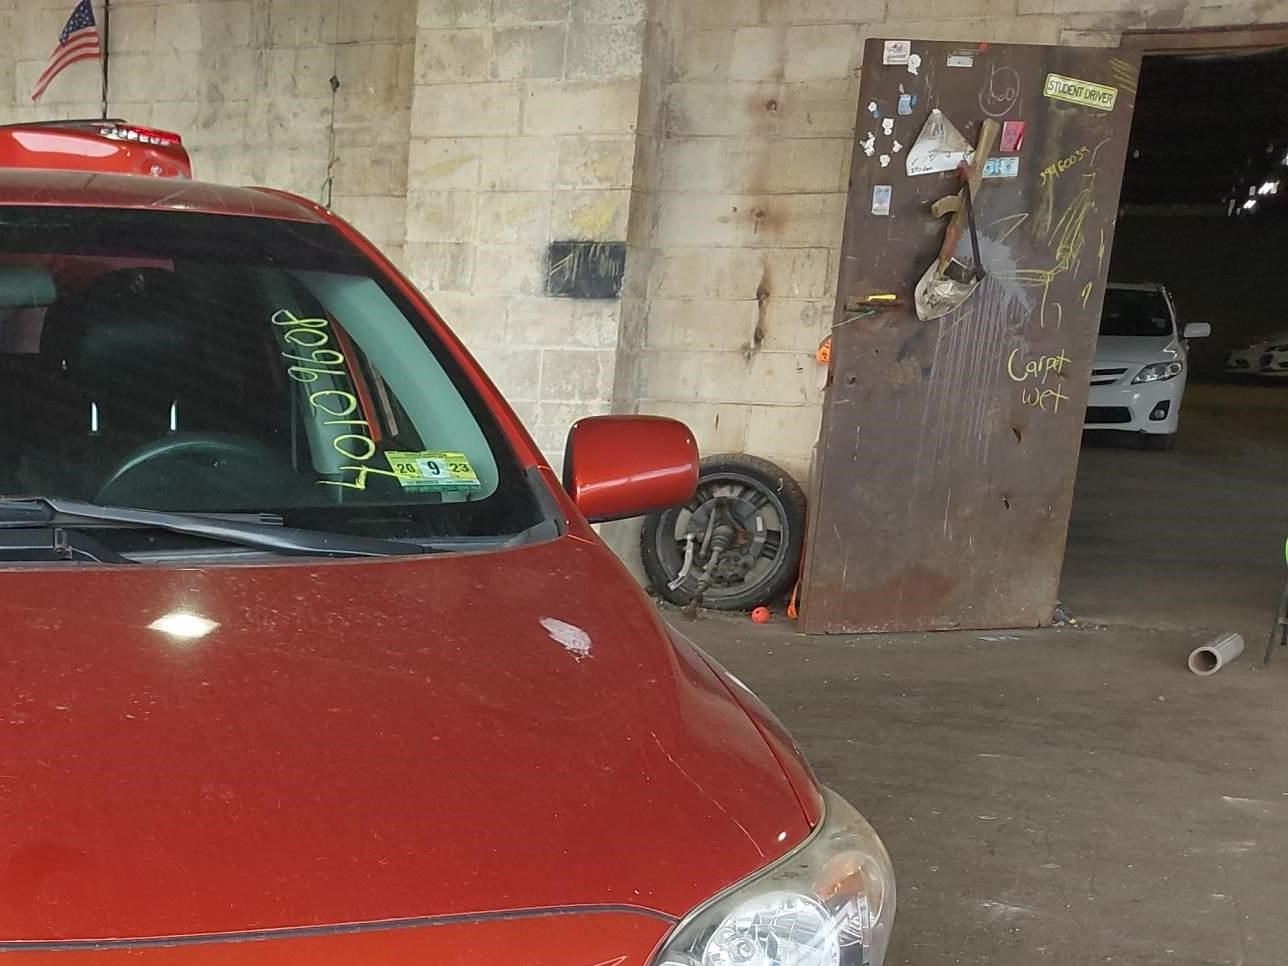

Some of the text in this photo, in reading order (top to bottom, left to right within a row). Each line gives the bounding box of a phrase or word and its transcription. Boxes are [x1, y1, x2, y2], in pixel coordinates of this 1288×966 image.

[1047, 80, 1114, 105] STUDENT DRIVER
[1008, 348, 1072, 385] Carpet
[271, 309, 411, 491] 40109608
[396, 460, 469, 476] 20 9 23
